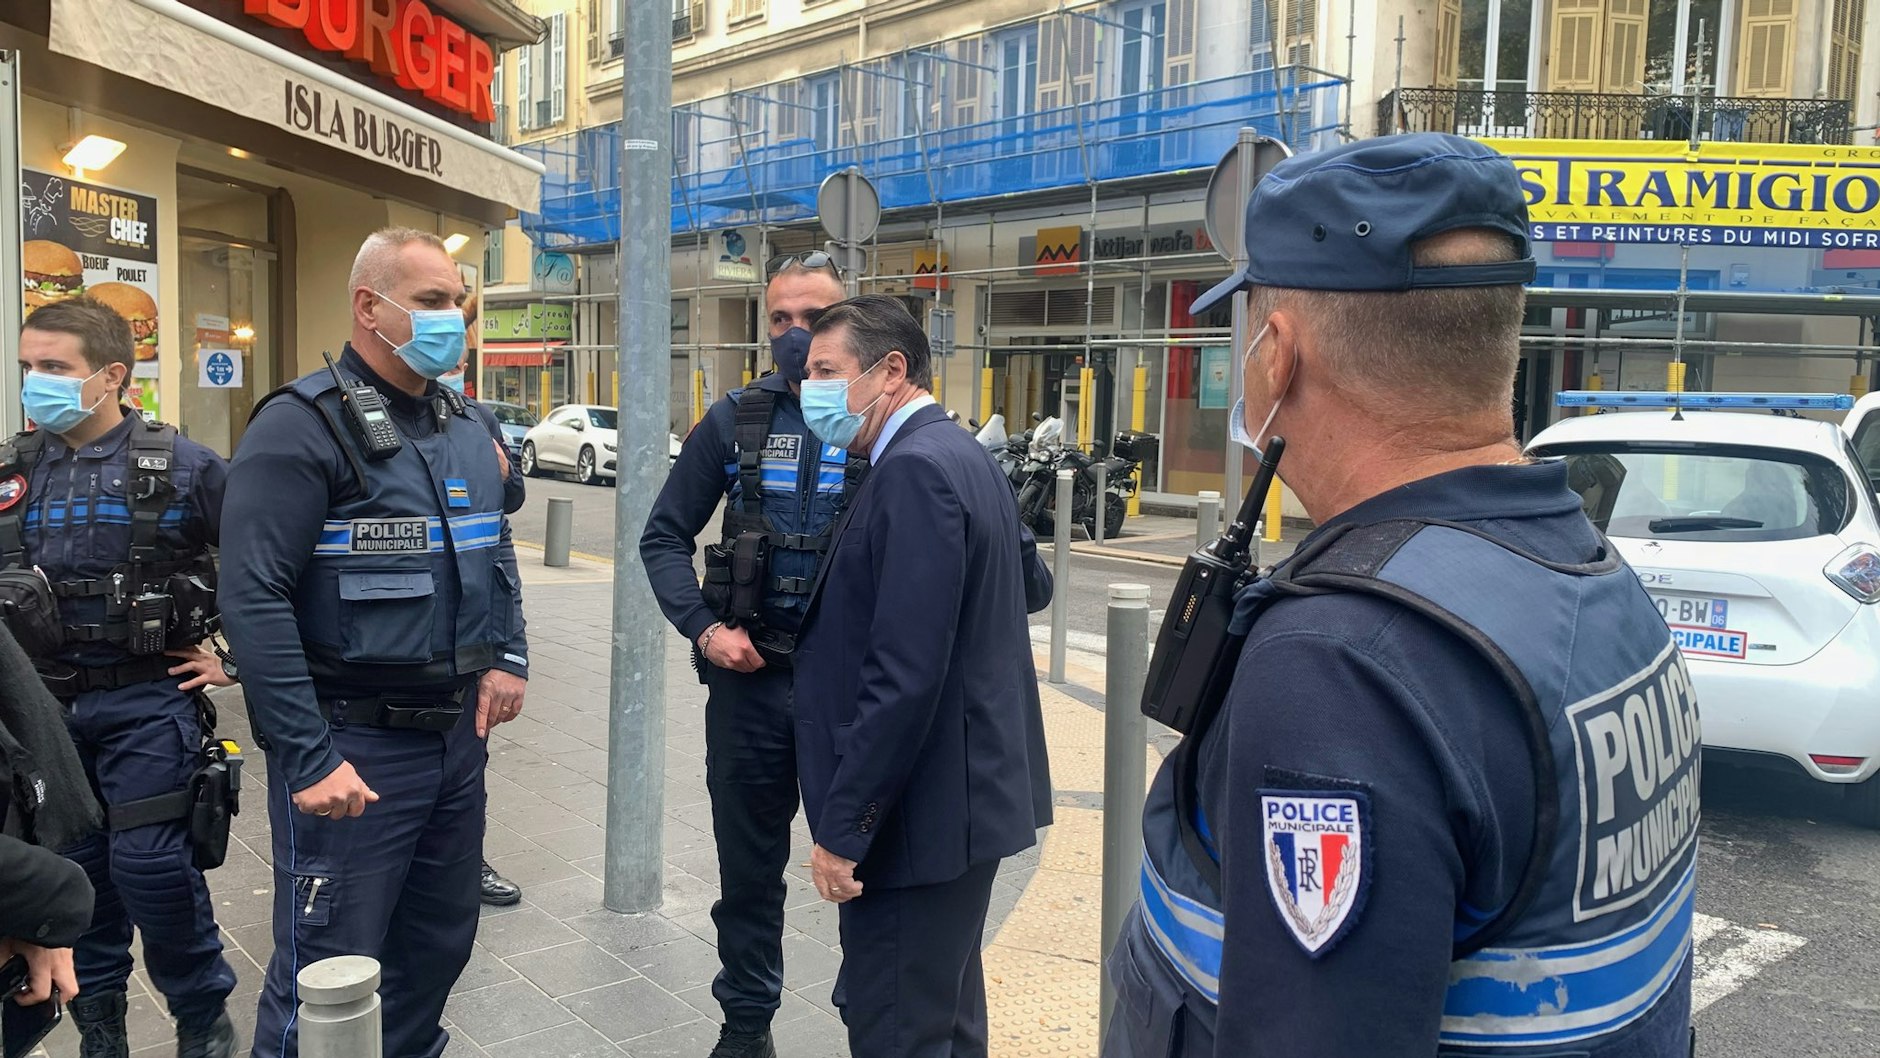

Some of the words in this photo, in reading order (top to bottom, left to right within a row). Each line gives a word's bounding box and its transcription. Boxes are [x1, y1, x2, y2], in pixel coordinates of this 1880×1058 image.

[284, 79, 347, 144] ISLA
[353, 107, 443, 177] BURGER
[1517, 157, 1880, 214] STRAMIGIO
[70, 186, 138, 221] MASTER
[1740, 215, 1774, 224] DE
[110, 217, 147, 244] CHEF
[1533, 225, 1545, 239] S
[1556, 226, 1581, 240] ET
[1592, 227, 1712, 243] PEINTURES
[1724, 230, 1751, 244] DU
[1764, 231, 1810, 246] MIDI
[1822, 232, 1878, 248] SOFR
[1094, 230, 1193, 259] Attijarwafa
[82, 254, 110, 271] BOEUF
[116, 267, 147, 283] POULET
[762, 437, 796, 449] LICE
[357, 523, 423, 539] POLICE
[356, 538, 424, 550] MUNICIPALE
[1712, 614, 1725, 626] 06
[1672, 630, 1741, 653] CIPALE
[1267, 801, 1354, 822] POLICE
[1268, 821, 1355, 834] MUNICIPALE
